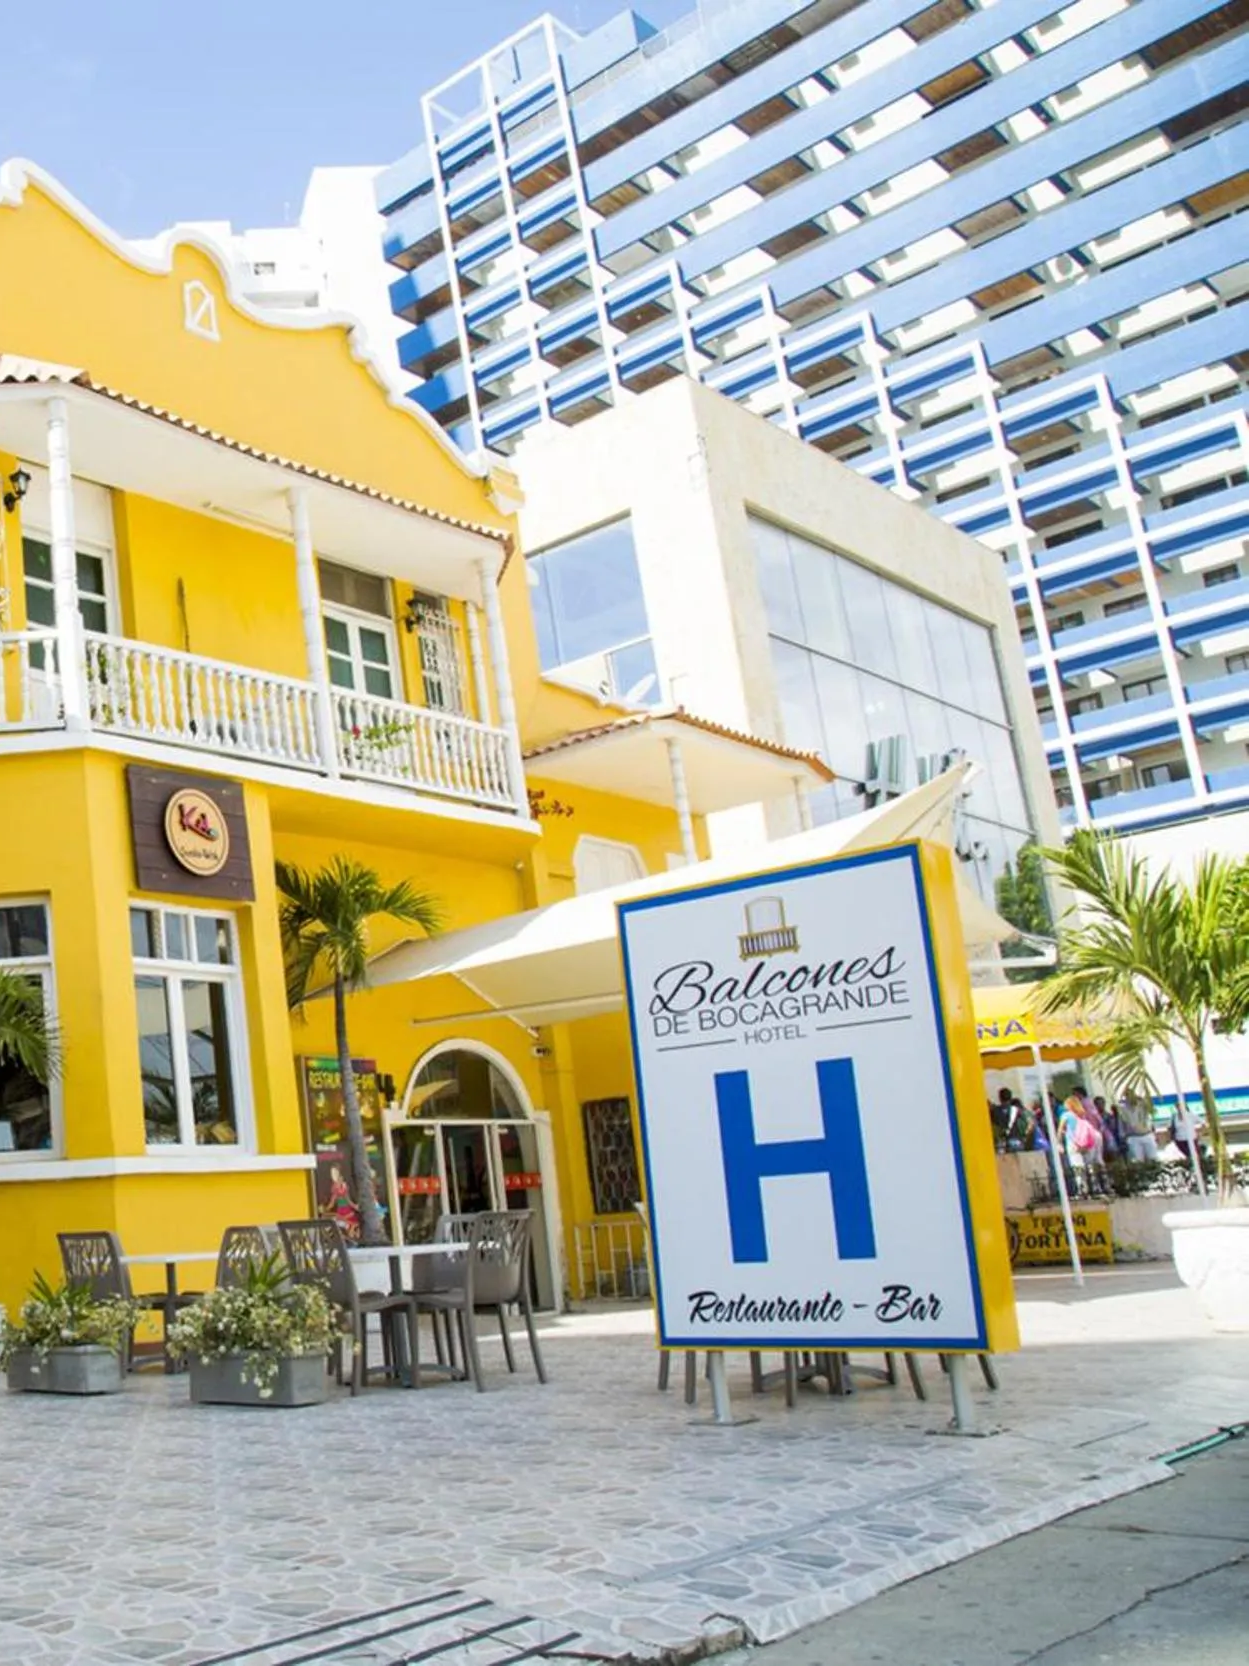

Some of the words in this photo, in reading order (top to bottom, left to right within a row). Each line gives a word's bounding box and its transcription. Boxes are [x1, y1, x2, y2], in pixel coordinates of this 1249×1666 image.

[649, 946, 906, 1016] Balcones
[653, 1013, 690, 1037] DE
[699, 980, 910, 1031] BOCAGRANDE
[744, 1024, 807, 1046] HOTEL
[713, 1056, 877, 1264] H
[687, 1291, 845, 1324] Restaurante
[875, 1284, 943, 1324] Bar
